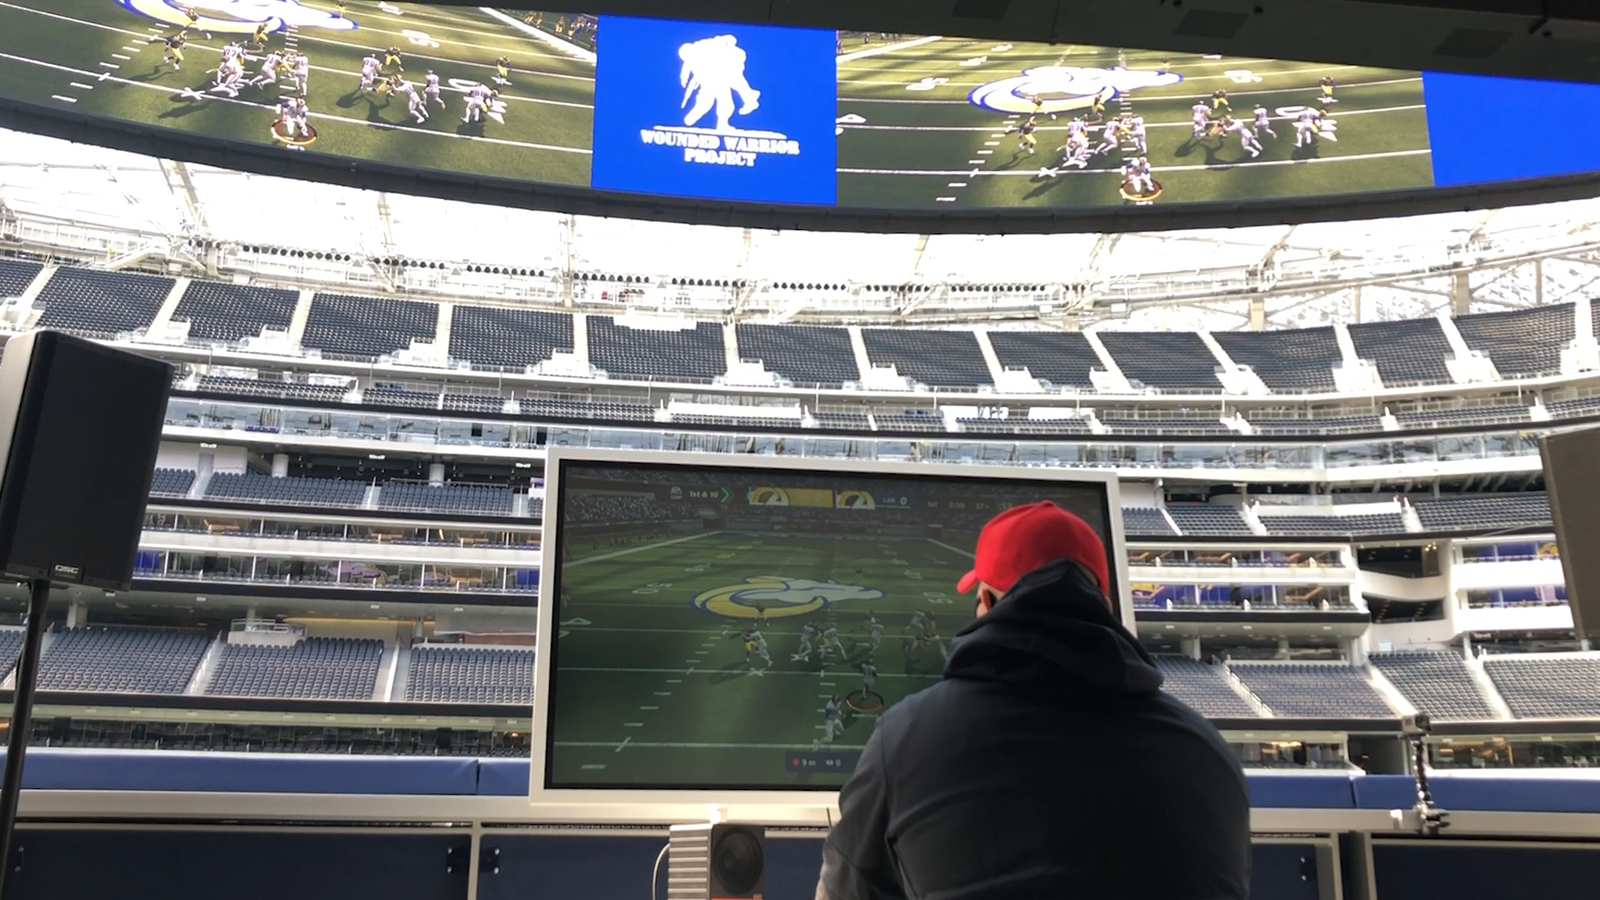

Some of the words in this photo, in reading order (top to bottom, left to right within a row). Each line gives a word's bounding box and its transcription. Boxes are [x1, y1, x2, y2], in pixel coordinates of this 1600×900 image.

[640, 129, 720, 149] WOUNDED
[723, 137, 800, 155] WARRIOR
[684, 148, 757, 167] PROJECT
